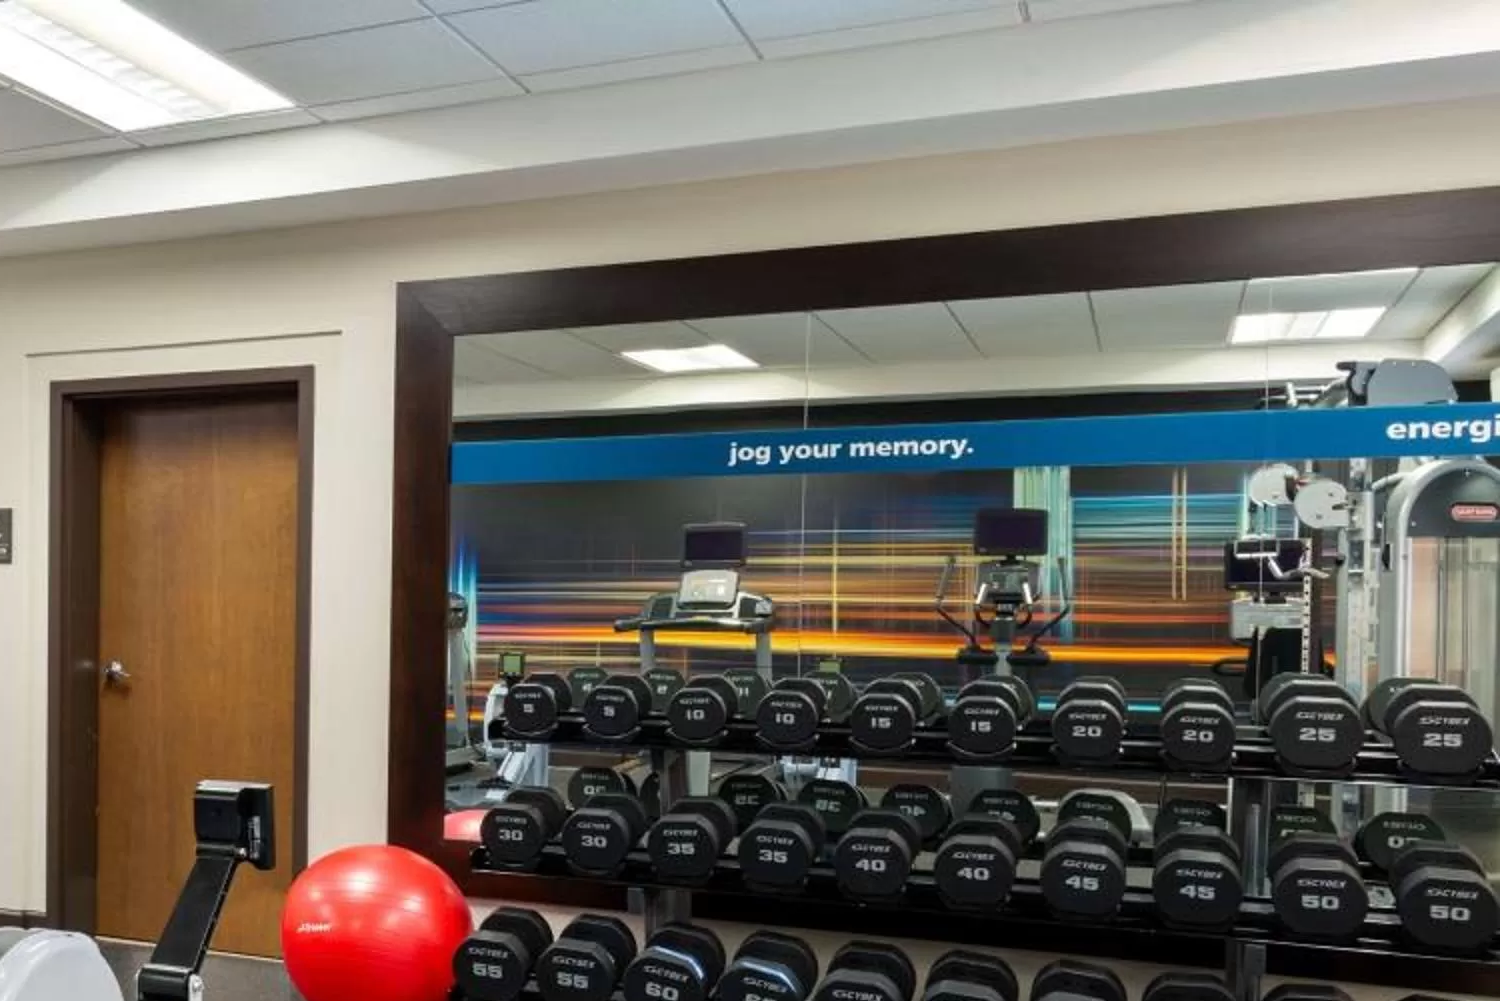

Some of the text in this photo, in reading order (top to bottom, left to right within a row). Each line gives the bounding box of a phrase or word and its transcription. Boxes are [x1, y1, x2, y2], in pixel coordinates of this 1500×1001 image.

[727, 438, 975, 466] jog your memory.
[687, 710, 704, 720] 10
[776, 713, 794, 724] 10
[872, 717, 891, 728] 15
[971, 721, 991, 732] 15
[1073, 726, 1101, 737] 20
[1183, 730, 1213, 742] 20
[1300, 728, 1335, 741] 25
[1423, 733, 1462, 747] 25
[500, 829, 523, 840] 30
[582, 836, 607, 847] 30
[668, 843, 694, 854] 35
[760, 850, 787, 863] 35
[856, 859, 885, 871] 40
[958, 868, 989, 880] 40
[1066, 876, 1098, 890] 45
[1180, 885, 1214, 899] 45
[1302, 895, 1339, 909] 50
[1430, 905, 1470, 920] 50
[473, 962, 502, 978] 55
[557, 972, 588, 988] 55
[646, 982, 678, 1001] 60
